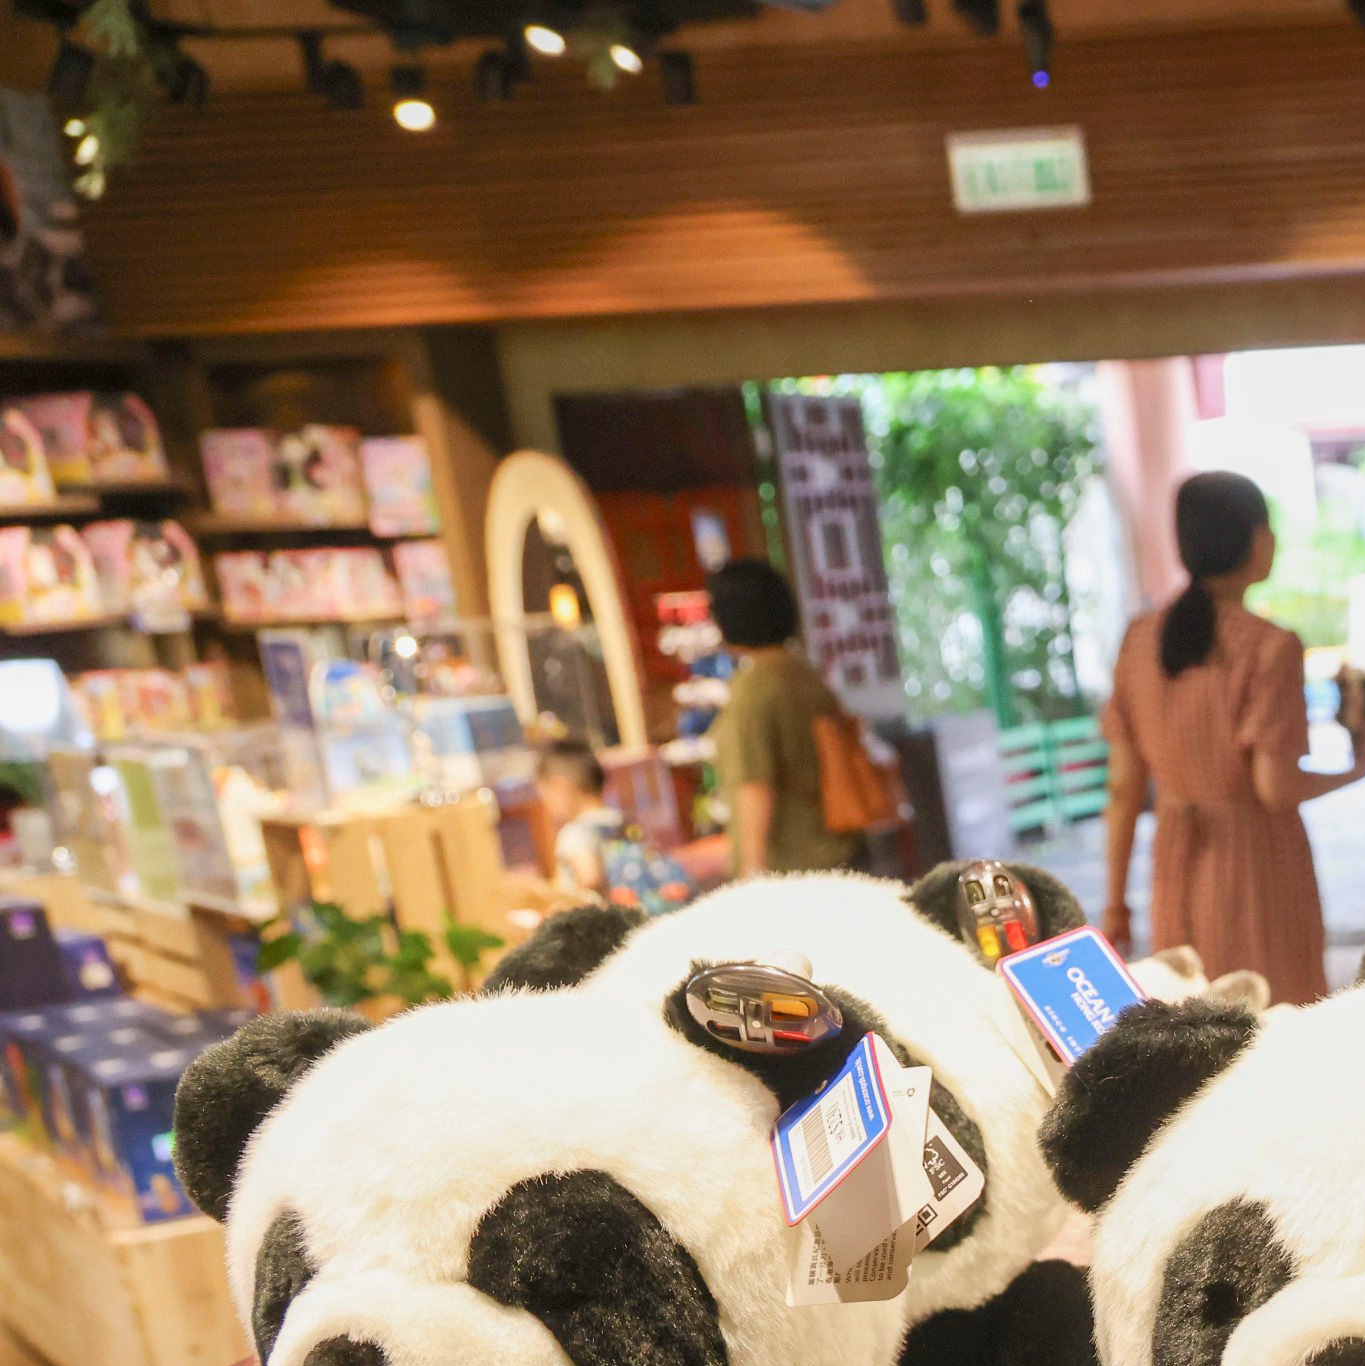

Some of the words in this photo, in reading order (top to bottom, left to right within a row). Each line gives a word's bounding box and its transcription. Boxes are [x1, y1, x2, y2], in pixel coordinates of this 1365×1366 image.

[1066, 966, 1116, 1024] OCEAN
[928, 1158, 945, 1175] FSC
[869, 1244, 880, 1282] Conserva
[888, 1229, 898, 1265] conserva
